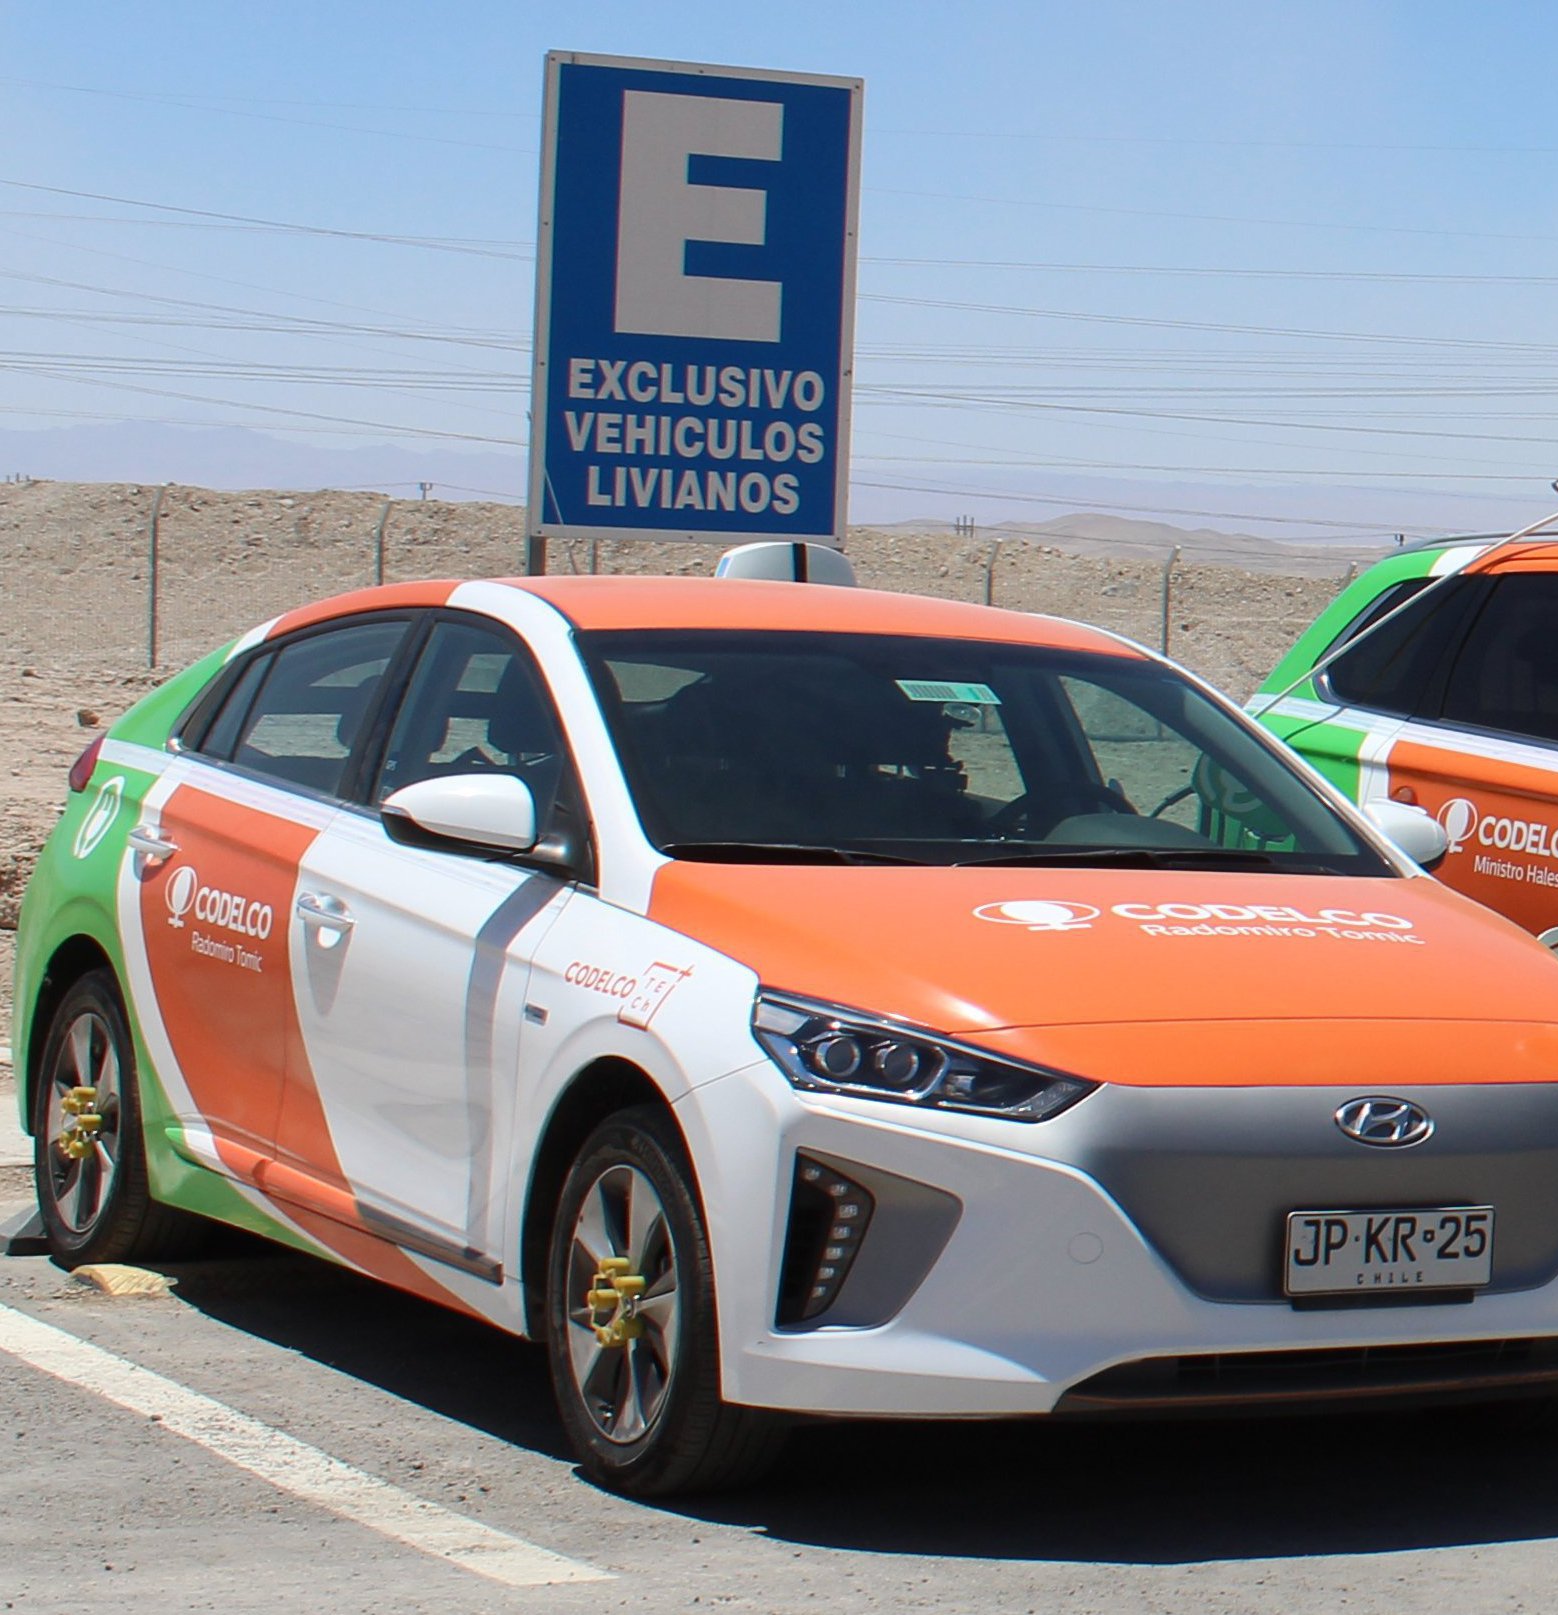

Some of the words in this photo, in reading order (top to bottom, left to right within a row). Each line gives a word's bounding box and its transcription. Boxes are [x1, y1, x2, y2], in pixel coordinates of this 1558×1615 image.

[614, 89, 785, 342] E
[568, 358, 825, 412] EXCLUSIVO
[564, 411, 825, 464] VEHICULOS
[587, 465, 800, 515] LIVIANOS
[1473, 855, 1524, 881] Ministro
[195, 886, 273, 940] CODELCO
[1111, 902, 1414, 930] CODELCO
[1140, 922, 1317, 938] Radomiro
[1315, 926, 1426, 945] Tomic
[191, 930, 235, 963] Radomiro
[235, 944, 263, 973] Tomic
[564, 961, 637, 998] CODELCO
[1356, 1271, 1424, 1285] CHILE
